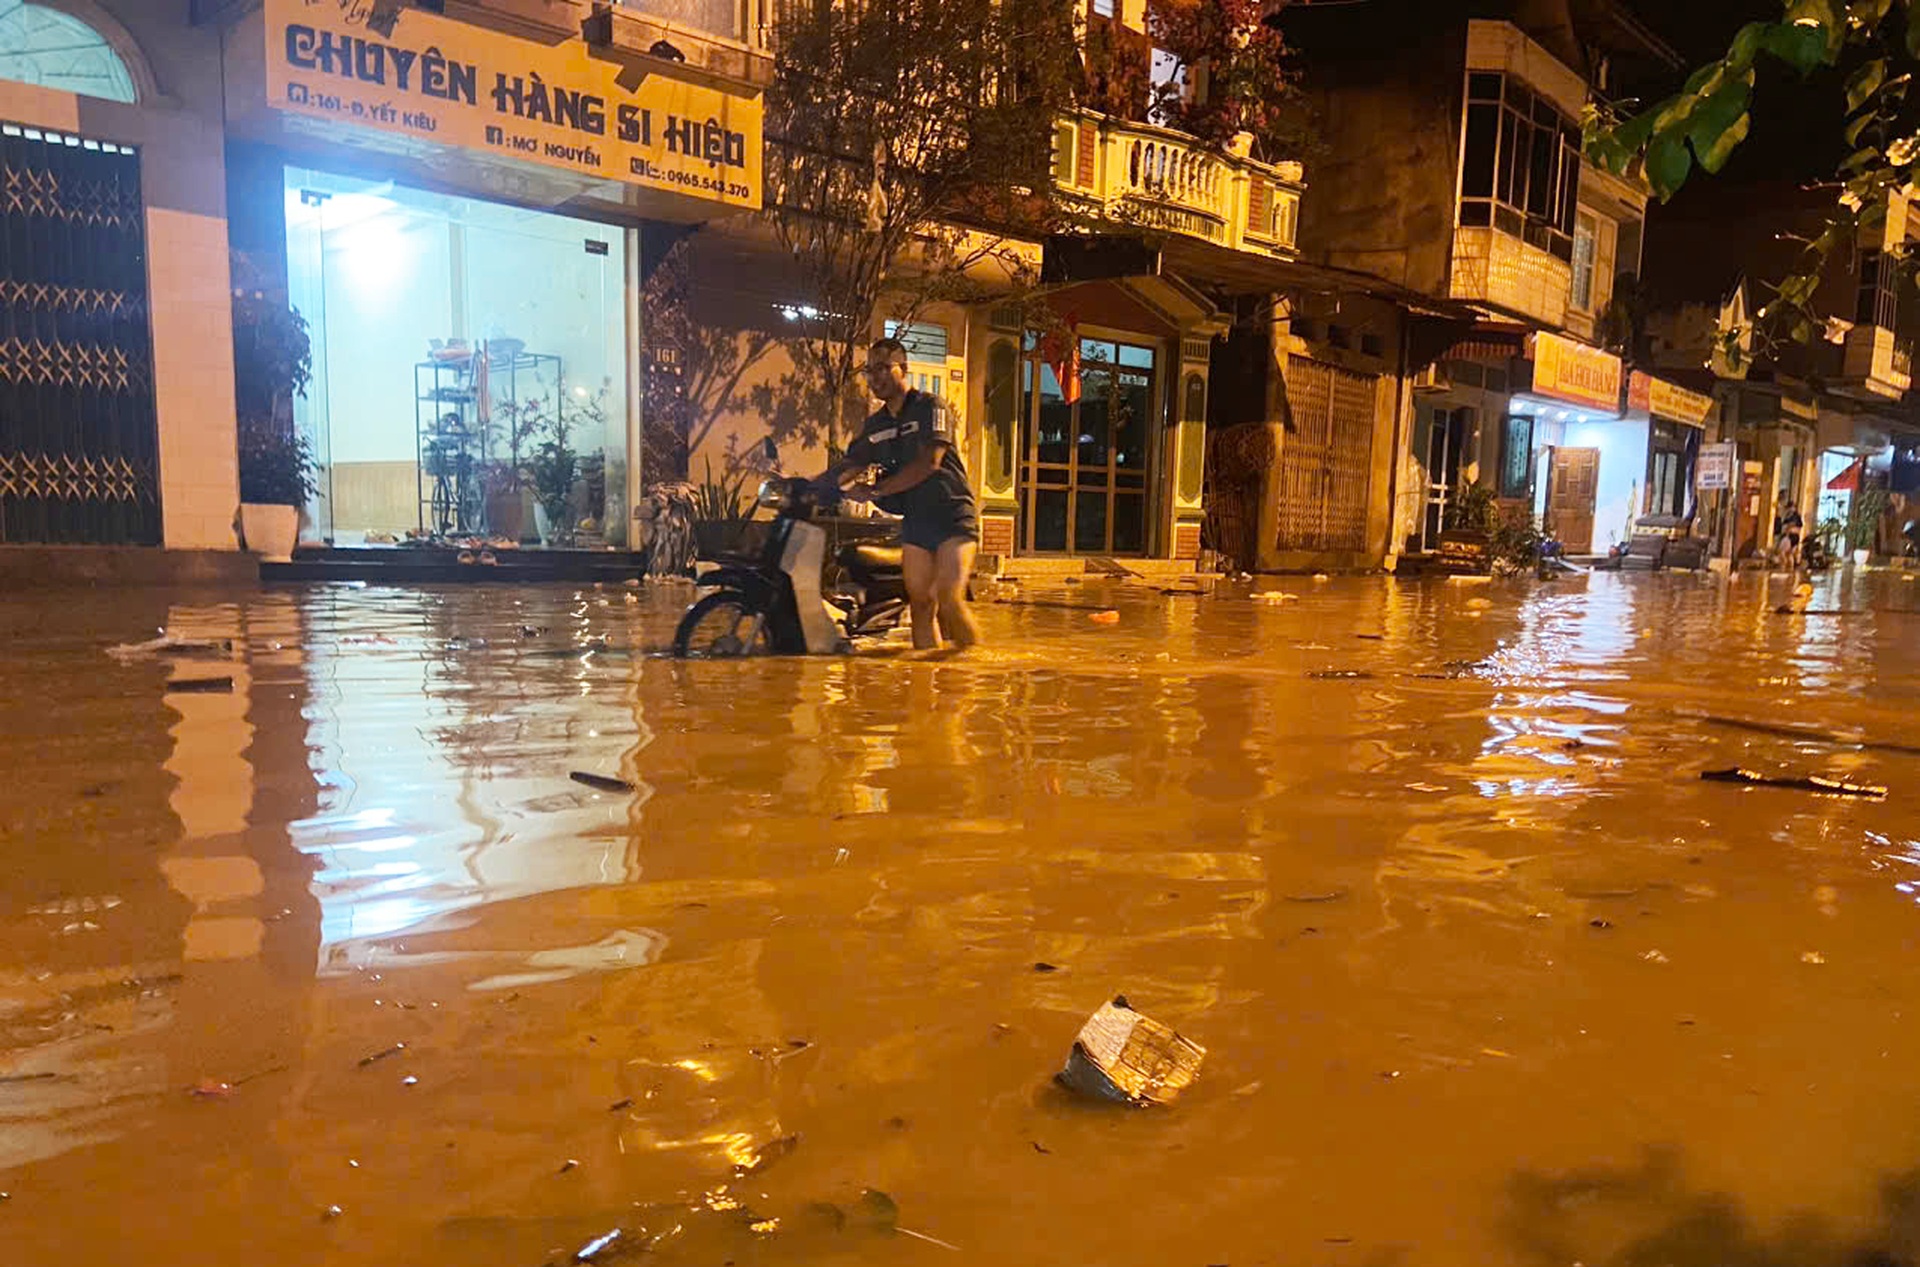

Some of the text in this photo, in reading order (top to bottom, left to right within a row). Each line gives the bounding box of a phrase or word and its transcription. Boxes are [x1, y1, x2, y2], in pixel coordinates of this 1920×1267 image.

[285, 23, 477, 105] CHUYÊN
[491, 71, 606, 136] HÀNG
[663, 116, 745, 169] HIỆU
[655, 348, 675, 364] 161
